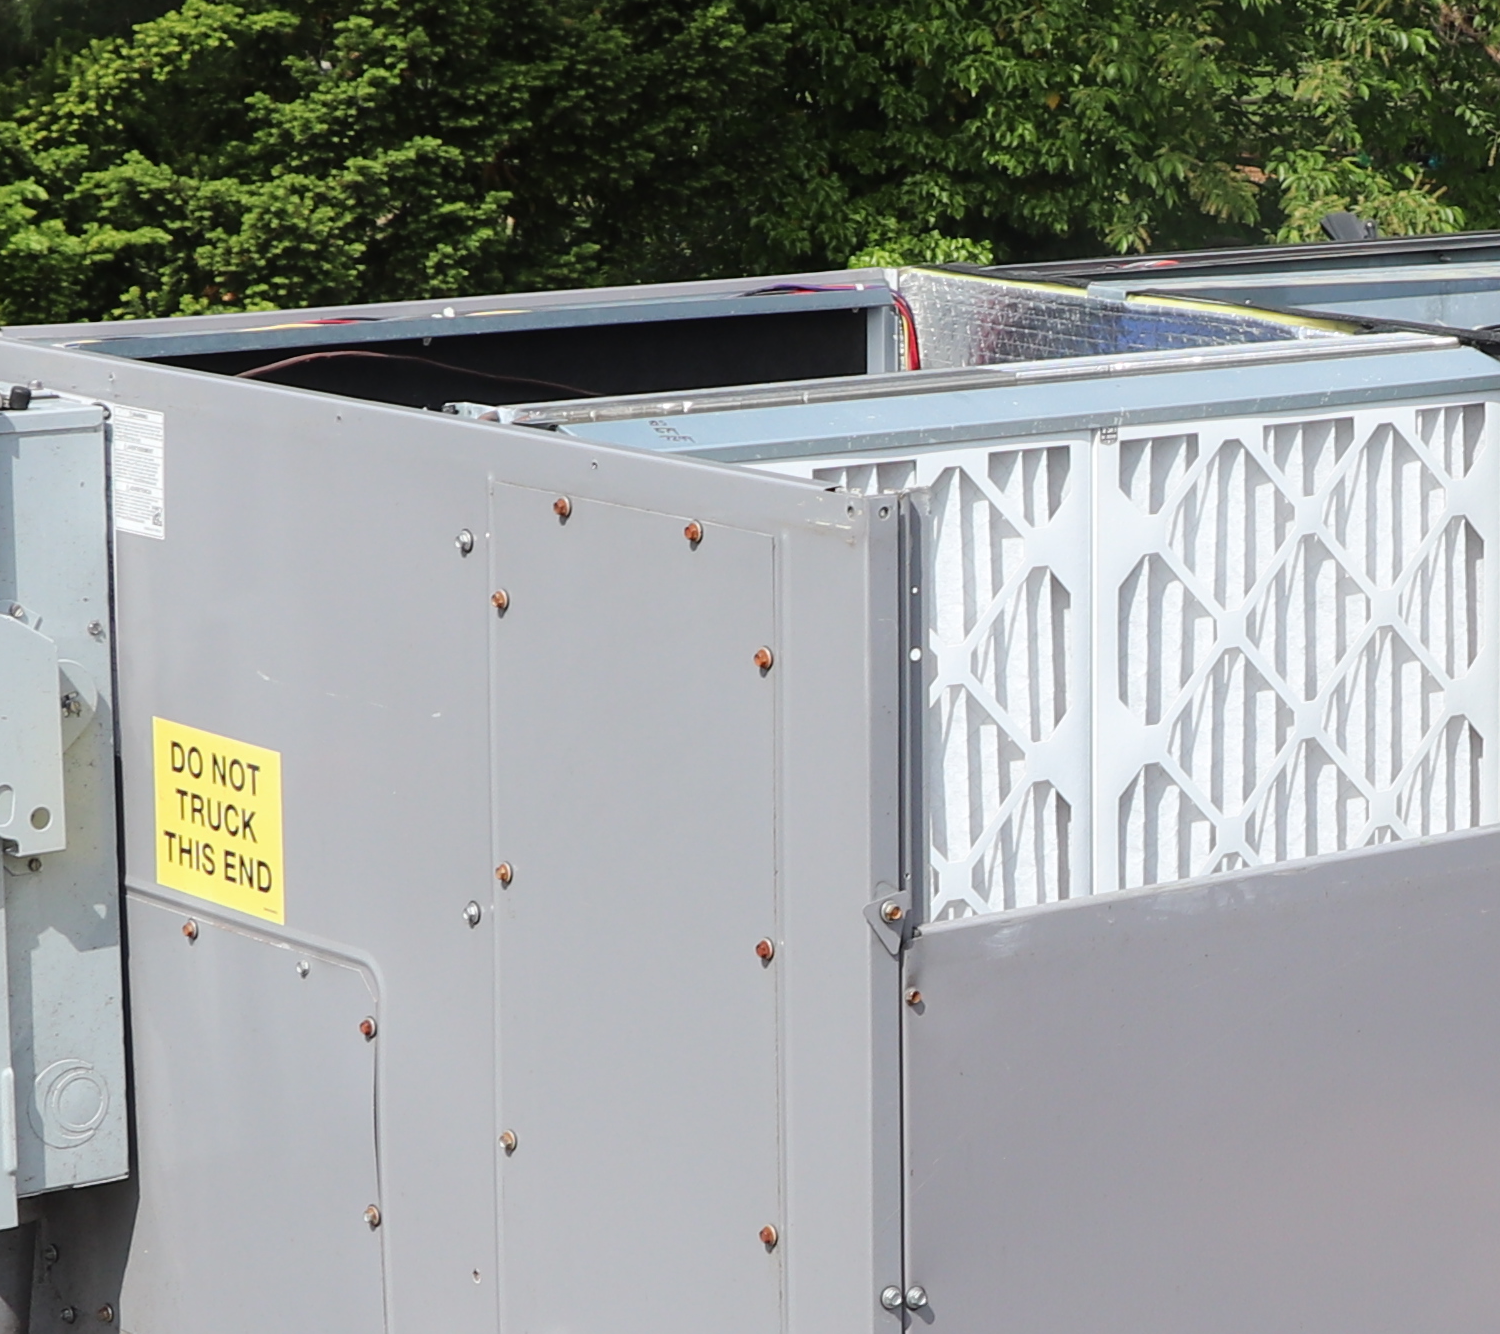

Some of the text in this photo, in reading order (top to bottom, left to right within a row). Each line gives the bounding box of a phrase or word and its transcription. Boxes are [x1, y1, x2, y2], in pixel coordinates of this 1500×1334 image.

[170, 740, 261, 797] DO NOT
[175, 788, 259, 844] TRUCK
[163, 830, 273, 894] THIS END
